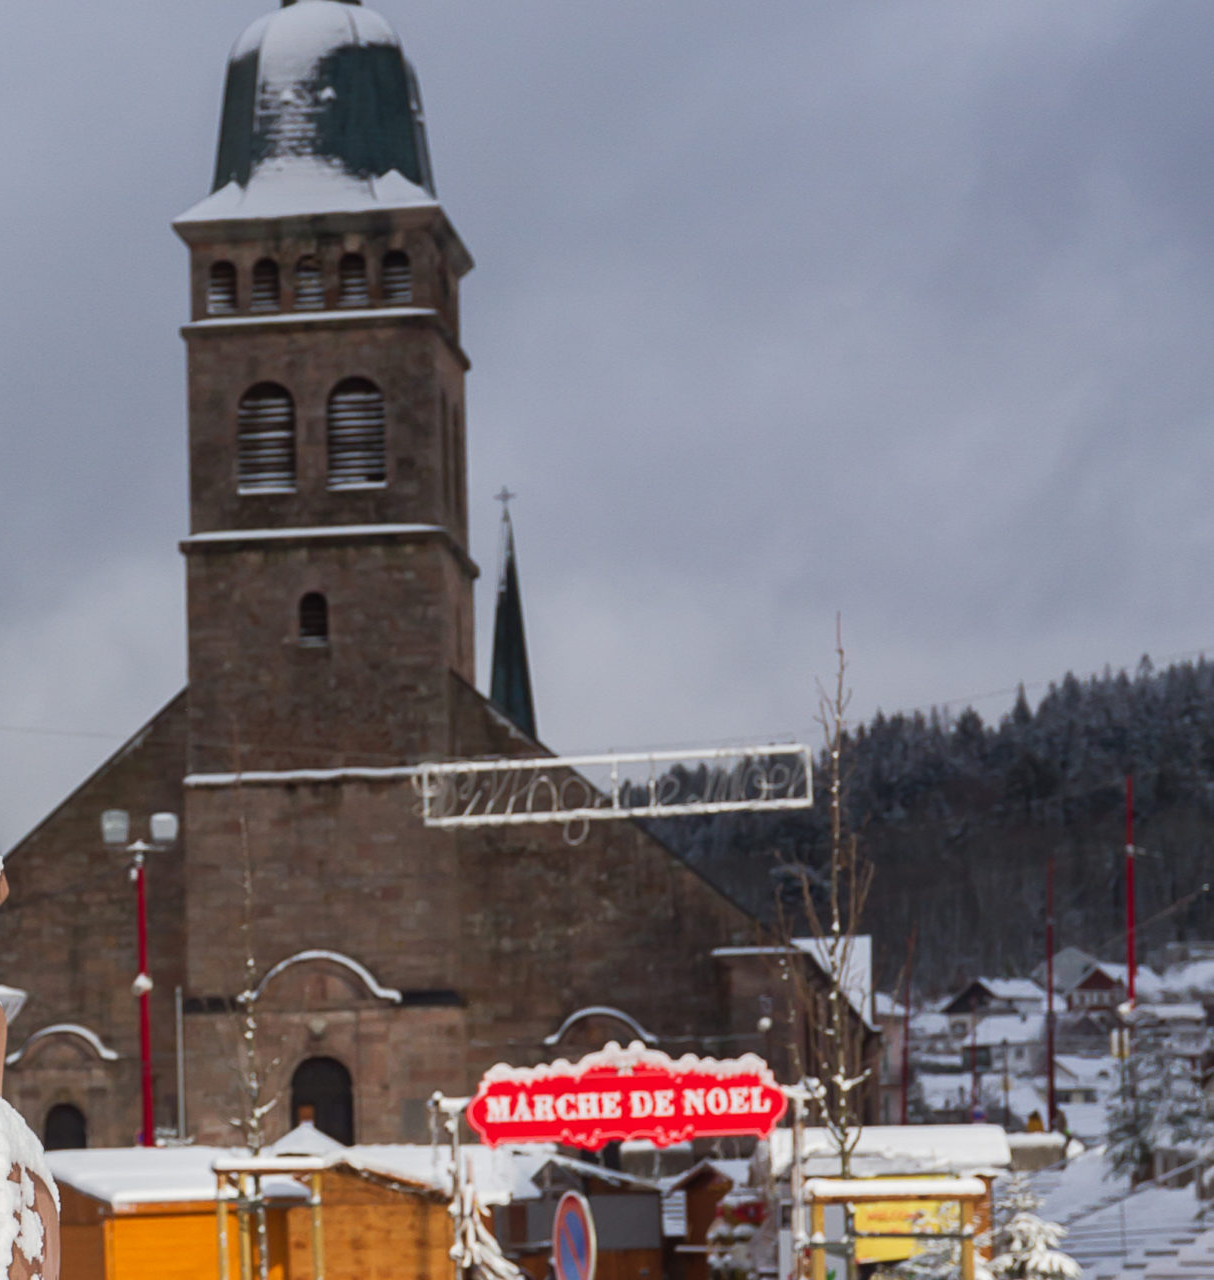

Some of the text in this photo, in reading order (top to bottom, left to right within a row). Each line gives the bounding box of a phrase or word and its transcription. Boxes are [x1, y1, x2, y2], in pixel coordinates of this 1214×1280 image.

[486, 1086, 772, 1123] MARCHE DE NOEL
